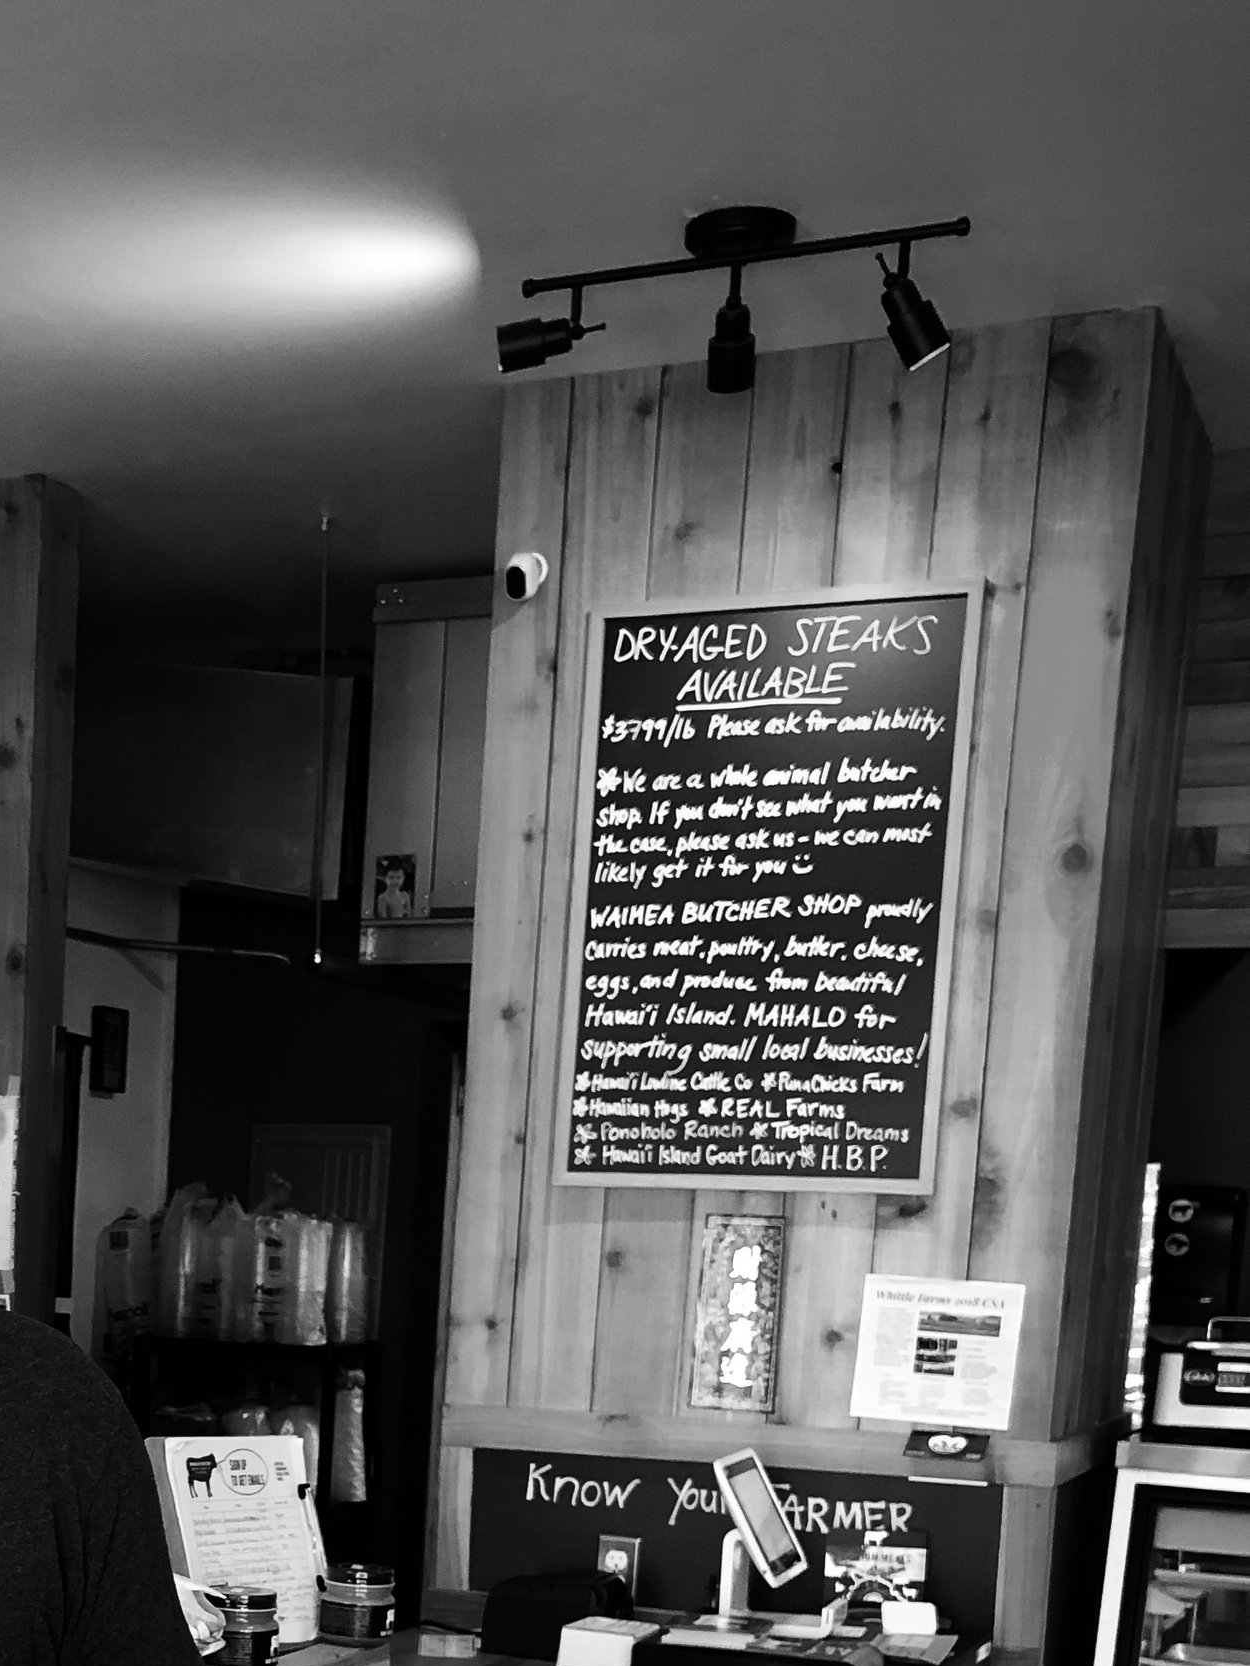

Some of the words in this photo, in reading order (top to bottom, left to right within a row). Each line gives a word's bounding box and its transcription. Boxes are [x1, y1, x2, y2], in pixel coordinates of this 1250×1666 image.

[613, 623, 767, 663] DRY-AGED
[788, 614, 938, 657] STEAKS
[676, 661, 856, 701] AVAILABLE
[707, 713, 761, 740] Please
[764, 711, 802, 735] ask
[805, 709, 837, 733] for
[837, 706, 946, 741] availability.
[623, 767, 647, 793] We
[652, 773, 682, 791] are
[686, 773, 705, 790] a
[710, 763, 759, 788] whole
[763, 761, 832, 786] animal
[837, 756, 918, 783] butcher
[649, 800, 671, 825] If
[674, 804, 705, 830] you
[708, 795, 754, 820] don't
[755, 799, 782, 819] see
[785, 790, 833, 817] what
[833, 797, 868, 823] you
[873, 786, 924, 811] want
[923, 786, 942, 811] in
[593, 834, 628, 856] the
[629, 836, 673, 857] case,
[675, 830, 731, 859] please
[735, 827, 771, 850] ask
[773, 831, 795, 848] us
[814, 829, 841, 846] we
[843, 828, 880, 846] can
[882, 822, 933, 844] most
[594, 859, 648, 890] likely
[651, 857, 689, 888] get
[695, 855, 715, 878] it
[718, 854, 749, 878] for
[752, 859, 788, 883] you
[590, 904, 675, 929] WAIMEA
[681, 897, 792, 924] BUTCHER
[798, 893, 862, 917] SHOP
[864, 898, 934, 929] proudly
[706, 935, 780, 964] poultry,
[853, 935, 924, 967] cheese,
[585, 974, 638, 1000] eggs,
[639, 968, 679, 989] and
[679, 970, 758, 998] produce
[765, 967, 809, 992] from
[814, 970, 908, 996] beautiful
[666, 1001, 736, 1026] Island.
[744, 1002, 847, 1028] MAHALO
[854, 1004, 898, 1029] for
[581, 1032, 693, 1076] supporting
[699, 1034, 759, 1062] small
[762, 1034, 811, 1061] local
[813, 1032, 928, 1068] businesses!
[690, 1070, 732, 1093] Cattle
[734, 1071, 754, 1091] Co
[862, 1072, 905, 1094] Farm
[589, 1097, 651, 1118] Hawaiian
[654, 1099, 689, 1124] Hogs
[721, 1098, 781, 1119] REAL
[786, 1097, 846, 1119] Farms
[601, 1121, 678, 1142] Ponoholo
[684, 1120, 744, 1141] Ranch
[770, 1120, 840, 1143] Tropical
[845, 1121, 909, 1143] Dreams
[659, 1144, 701, 1166] Island
[706, 1144, 748, 1166] Goat
[751, 1144, 797, 1170] Dairy
[525, 1463, 641, 1510] Know
